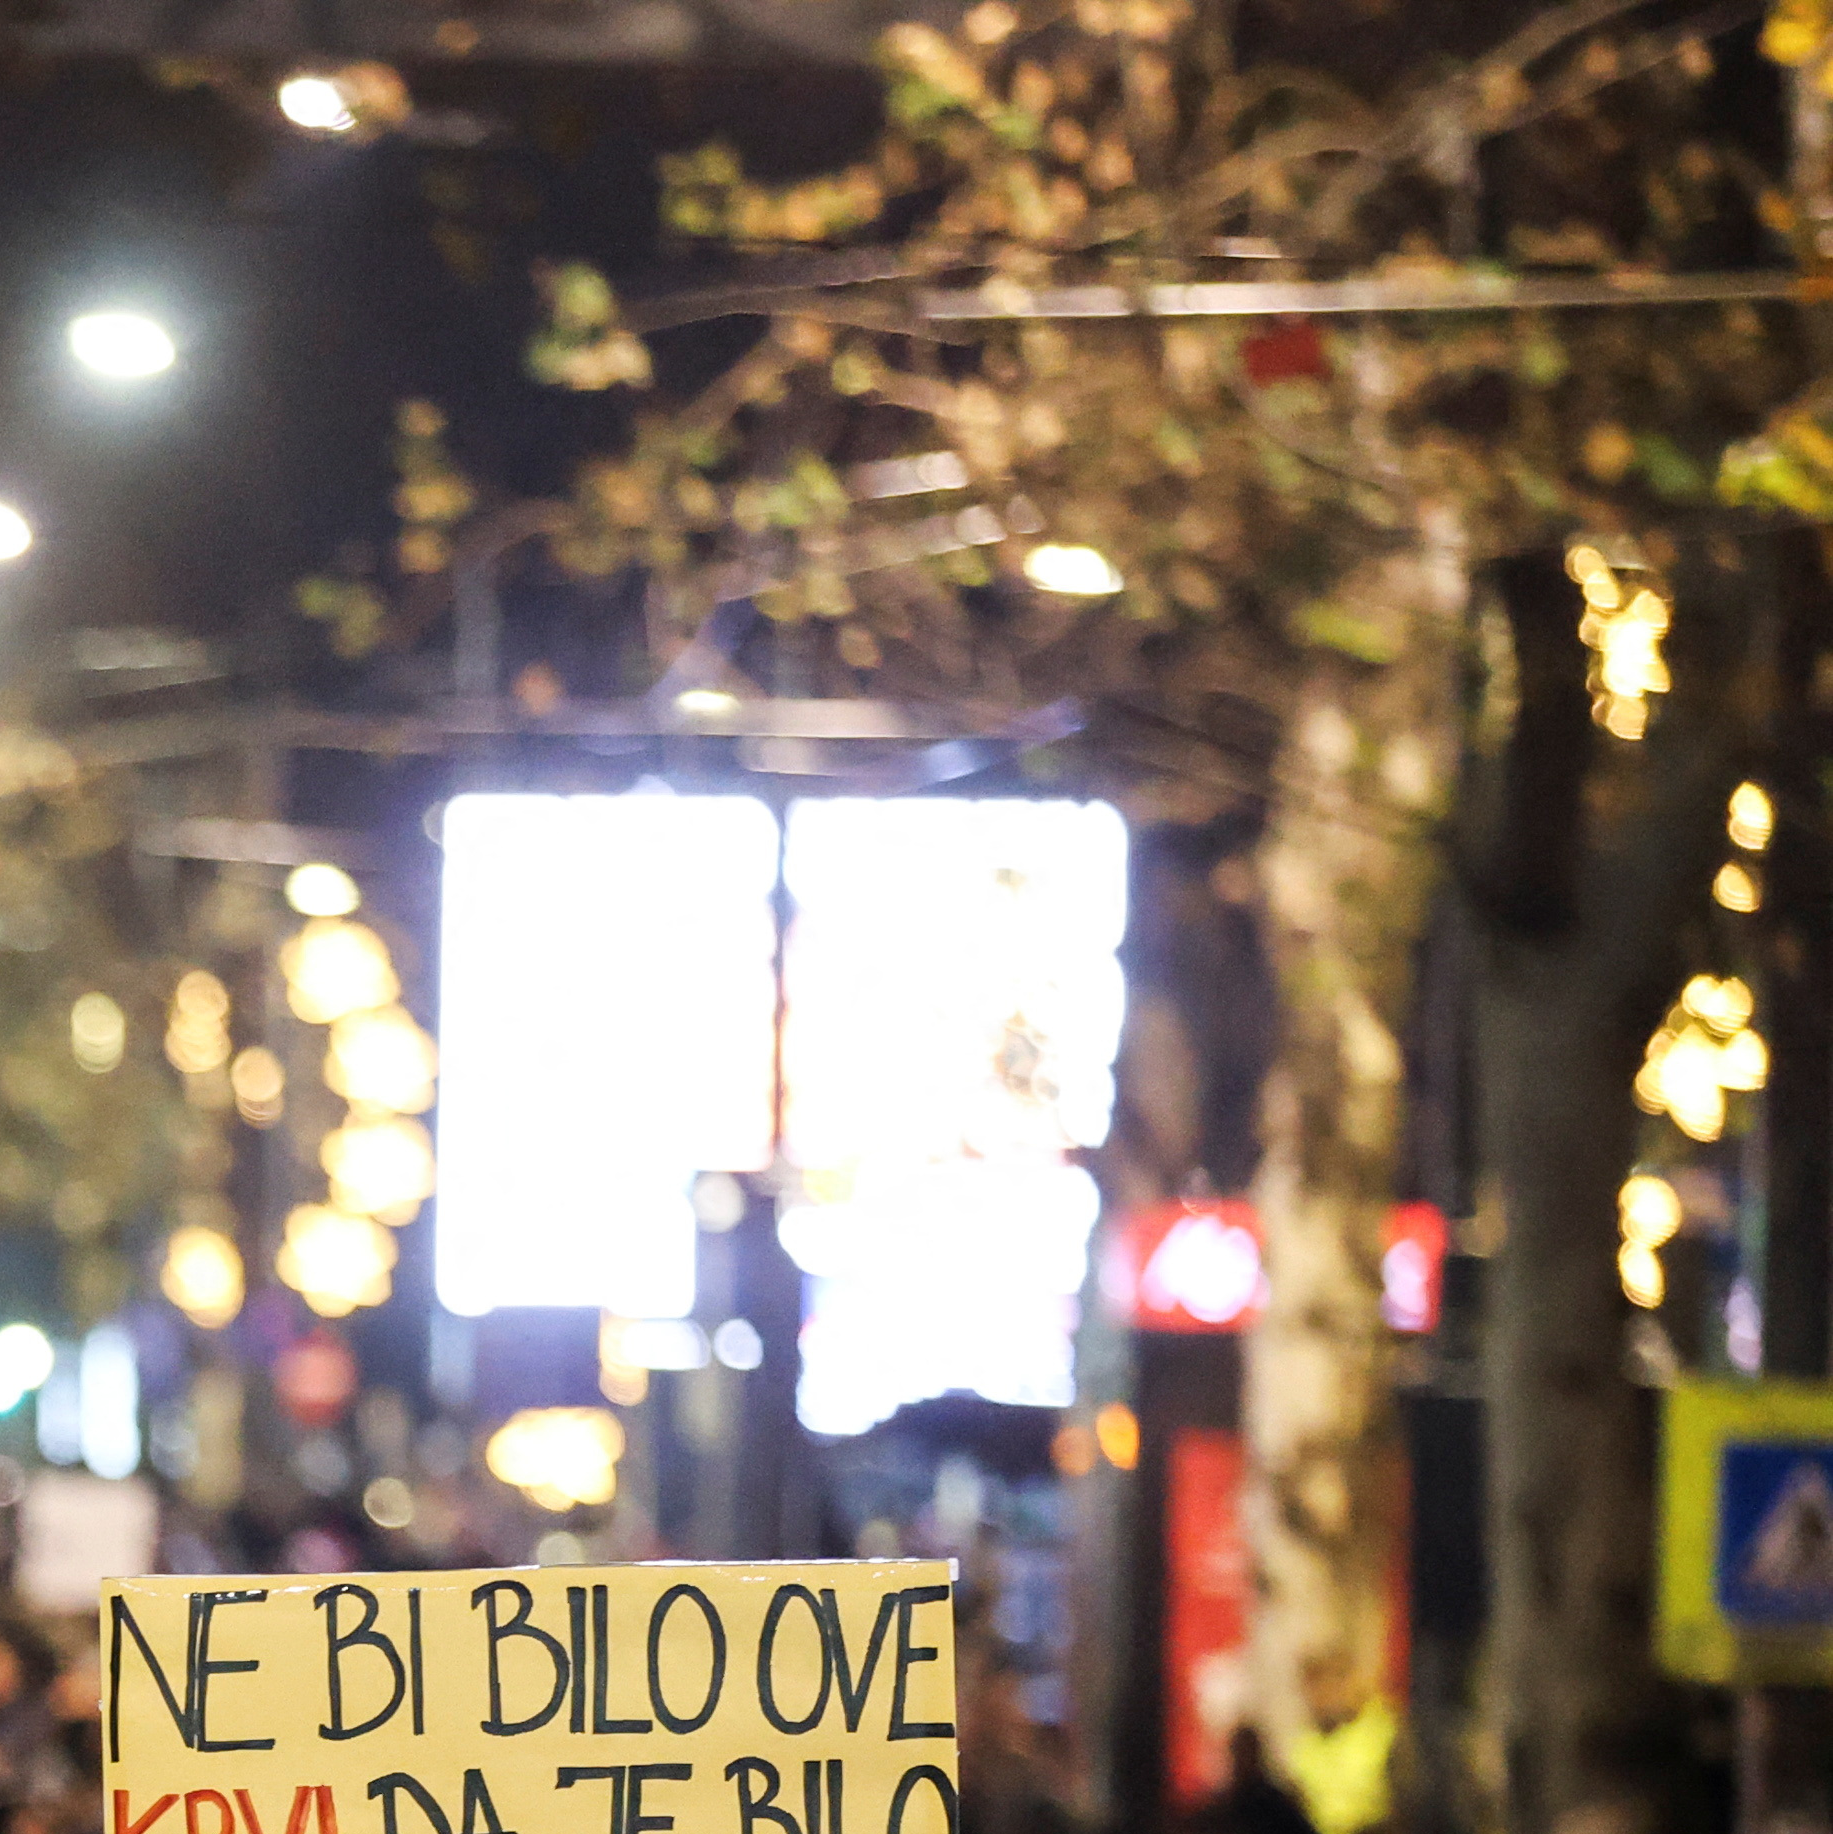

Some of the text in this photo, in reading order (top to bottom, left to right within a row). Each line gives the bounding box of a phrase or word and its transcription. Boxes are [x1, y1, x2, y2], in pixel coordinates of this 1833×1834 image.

[110, 1580, 956, 1763] NE BI BILO OVE
